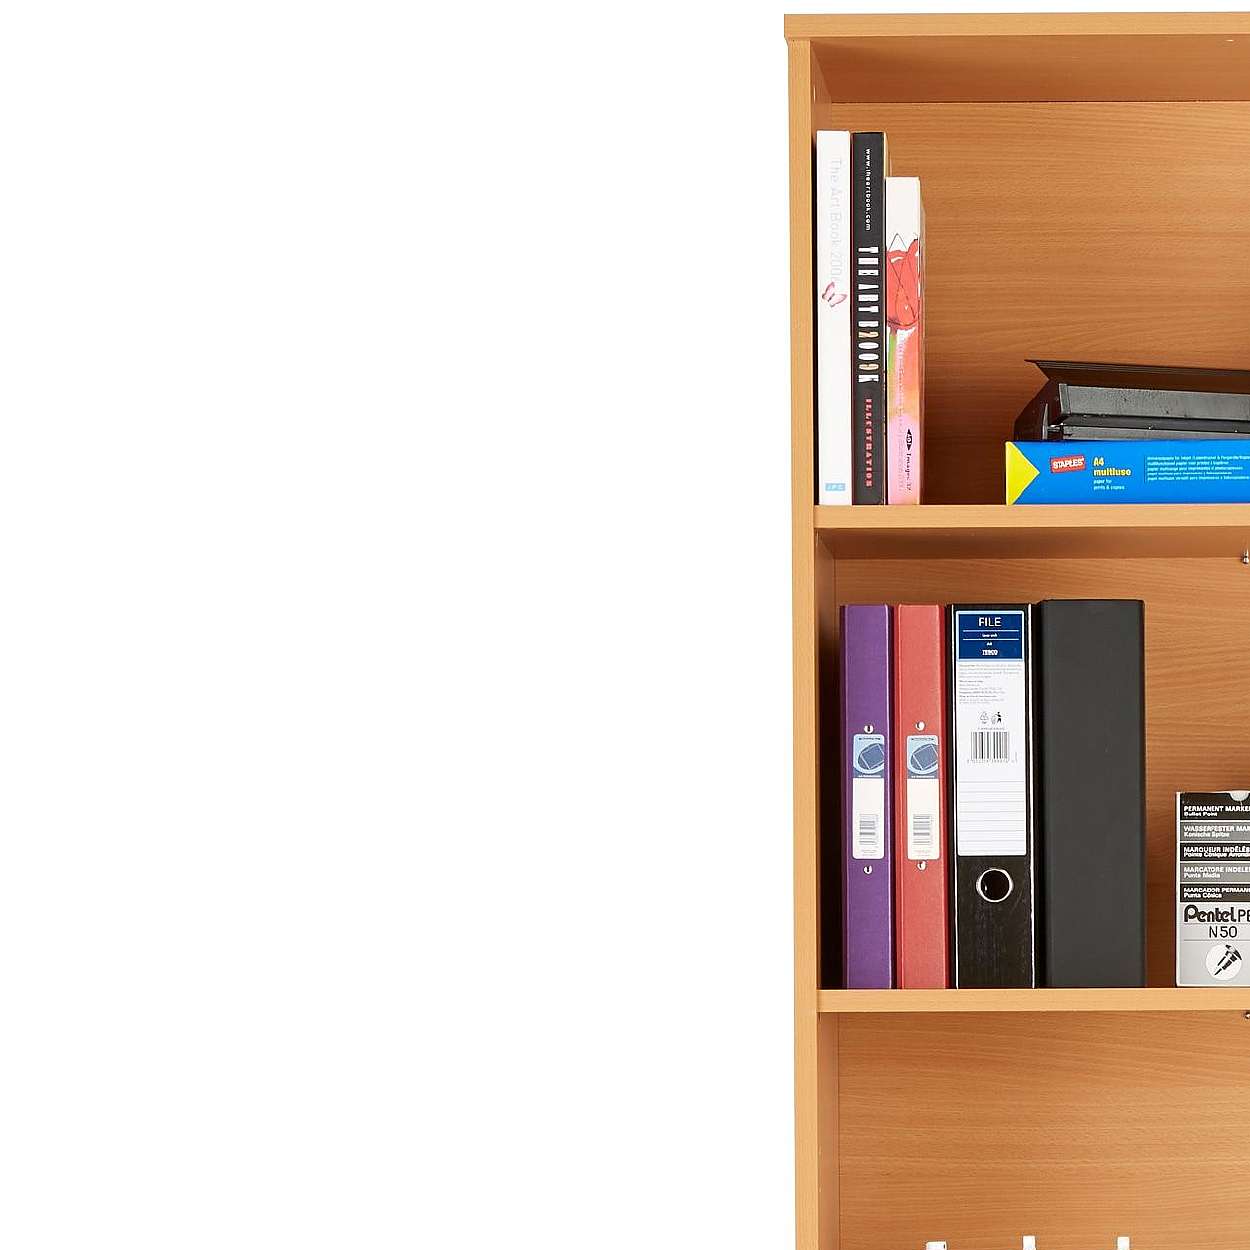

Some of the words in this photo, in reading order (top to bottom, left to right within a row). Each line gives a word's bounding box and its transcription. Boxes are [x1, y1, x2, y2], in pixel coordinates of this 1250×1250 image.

[858, 246, 879, 276] THE
[858, 283, 879, 313] ART
[1052, 458, 1085, 470] STAPLES
[1094, 457, 1105, 467] A4
[1094, 468, 1132, 476] multiuse
[979, 617, 1002, 627] FILE
[1184, 904, 1236, 922] Pentel
